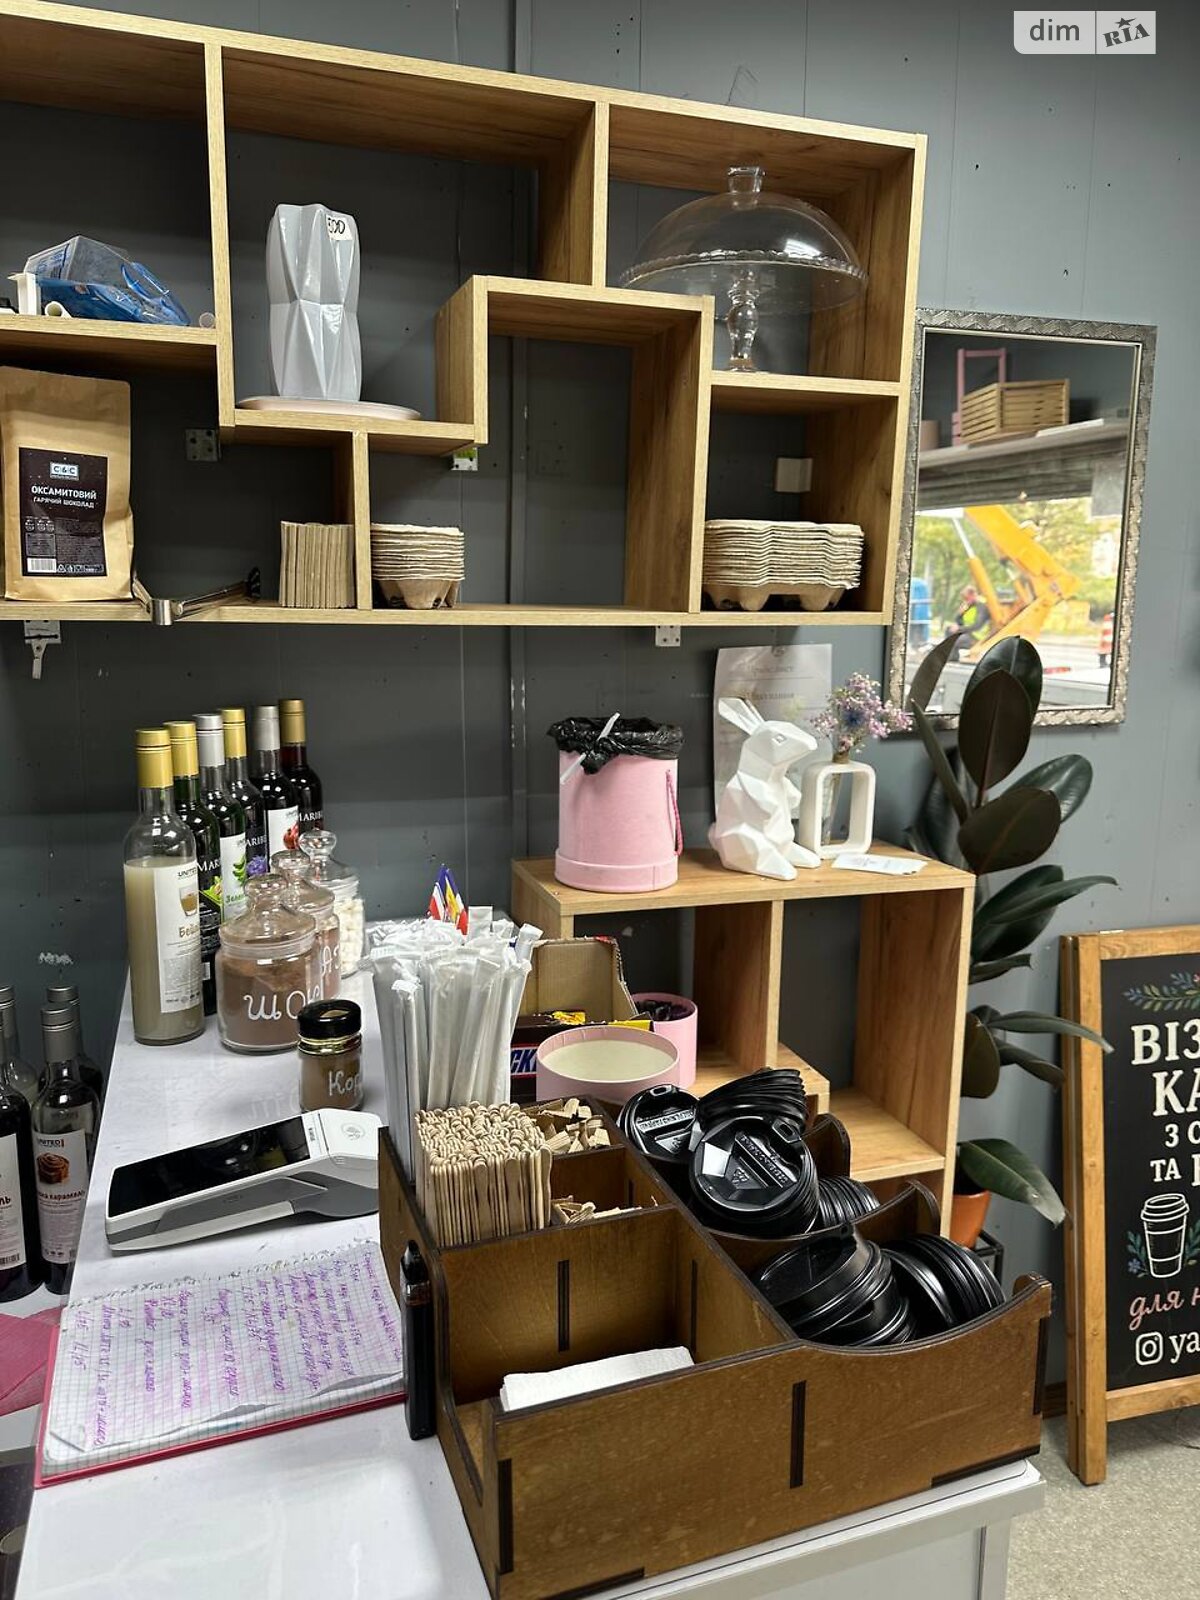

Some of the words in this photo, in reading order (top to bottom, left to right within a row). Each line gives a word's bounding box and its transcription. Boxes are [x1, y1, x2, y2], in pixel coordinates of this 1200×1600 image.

[31, 484, 97, 501] ОКСАМИТОВИЙ
[63, 499, 95, 510] ШОКОЛАД
[1150, 1157, 1182, 1182] ТА
[1129, 1290, 1185, 1331] для
